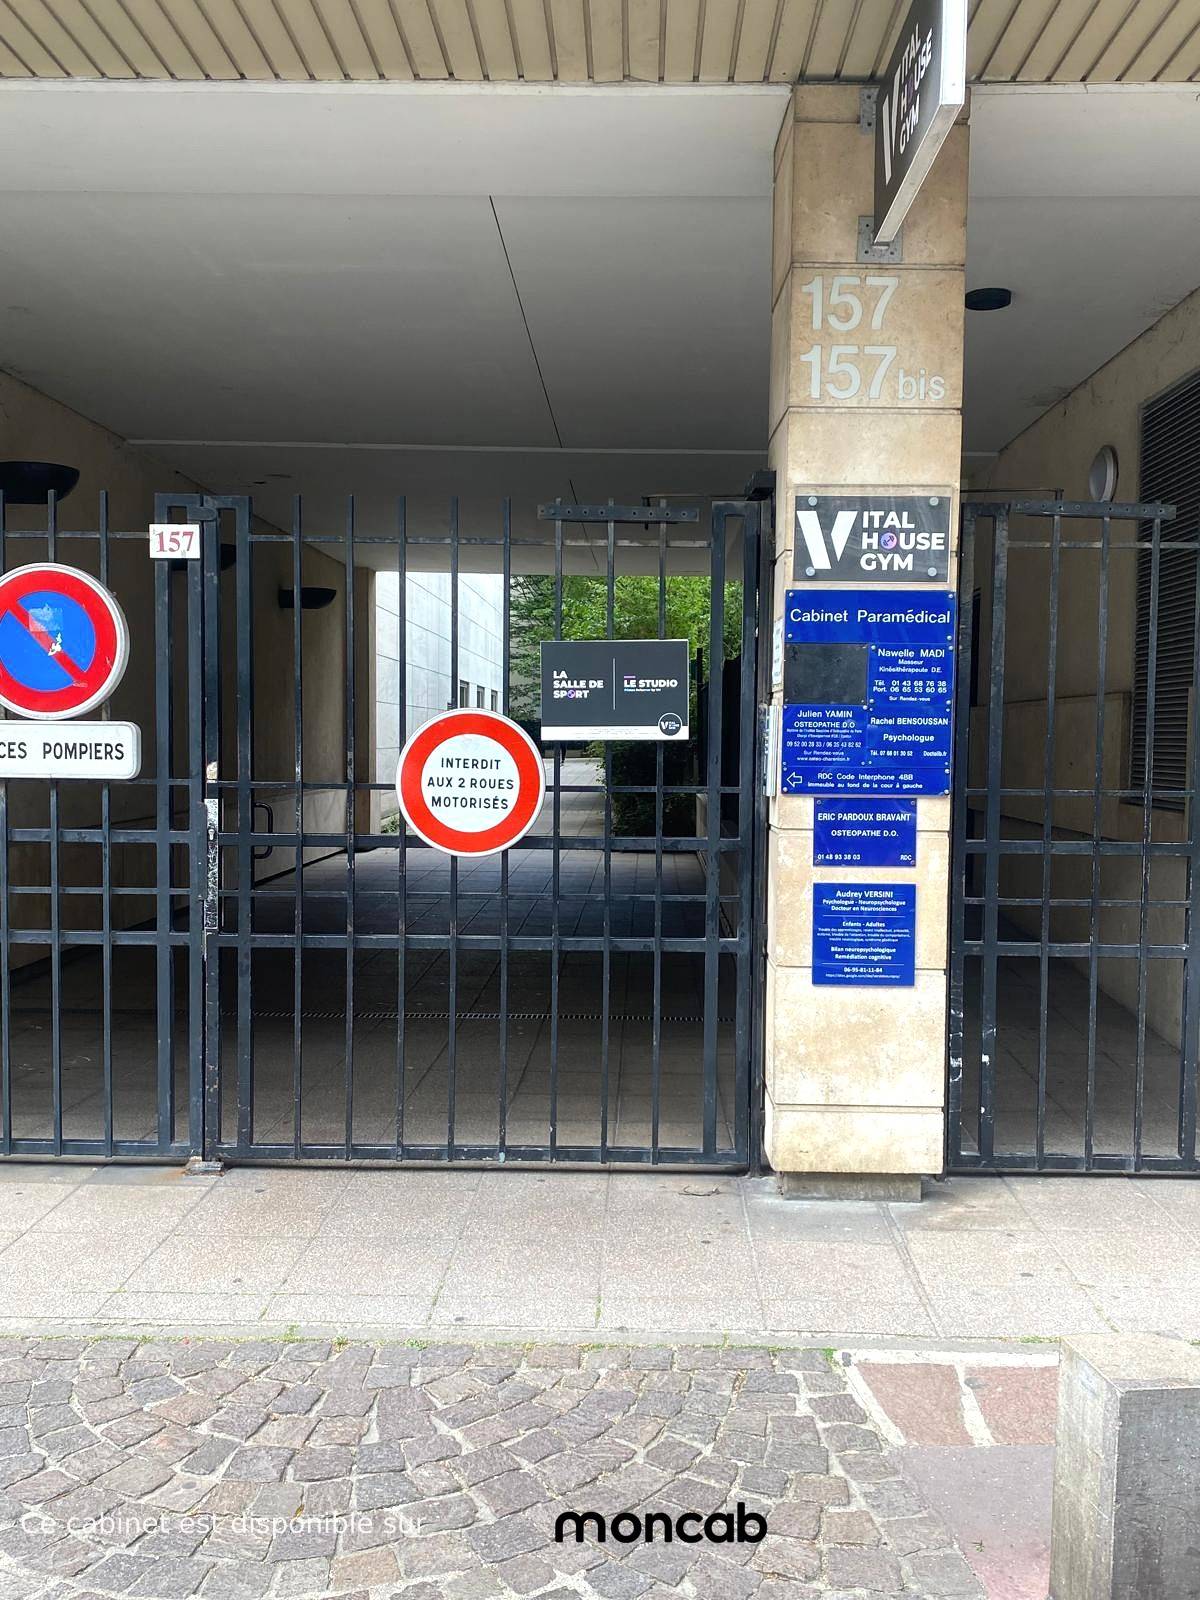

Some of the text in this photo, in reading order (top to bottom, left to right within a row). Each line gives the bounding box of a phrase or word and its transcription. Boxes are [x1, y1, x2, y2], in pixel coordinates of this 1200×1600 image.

[900, 94, 920, 154] GYM
[802, 275, 899, 331] 157
[800, 344, 945, 401] 157 bis
[862, 511, 915, 528] ITAL
[156, 531, 194, 552] 157
[861, 532, 946, 550] HOUSE
[860, 553, 914, 571] GYM
[790, 608, 950, 624] Cabinet Paramédical
[878, 648, 945, 658] Nawelle MADI
[553, 670, 568, 679] LA
[553, 680, 604, 689] SALLE DE
[624, 679, 678, 688] LE STUDIO
[553, 690, 590, 699] SPORT
[883, 734, 935, 743] Psychologue
[42, 742, 124, 760] POMPIERS
[441, 758, 501, 770] INTERDIT
[427, 777, 514, 790] AUX 2 ROUES
[432, 796, 508, 810] MOTORISÉS
[836, 890, 862, 899] Audrey
